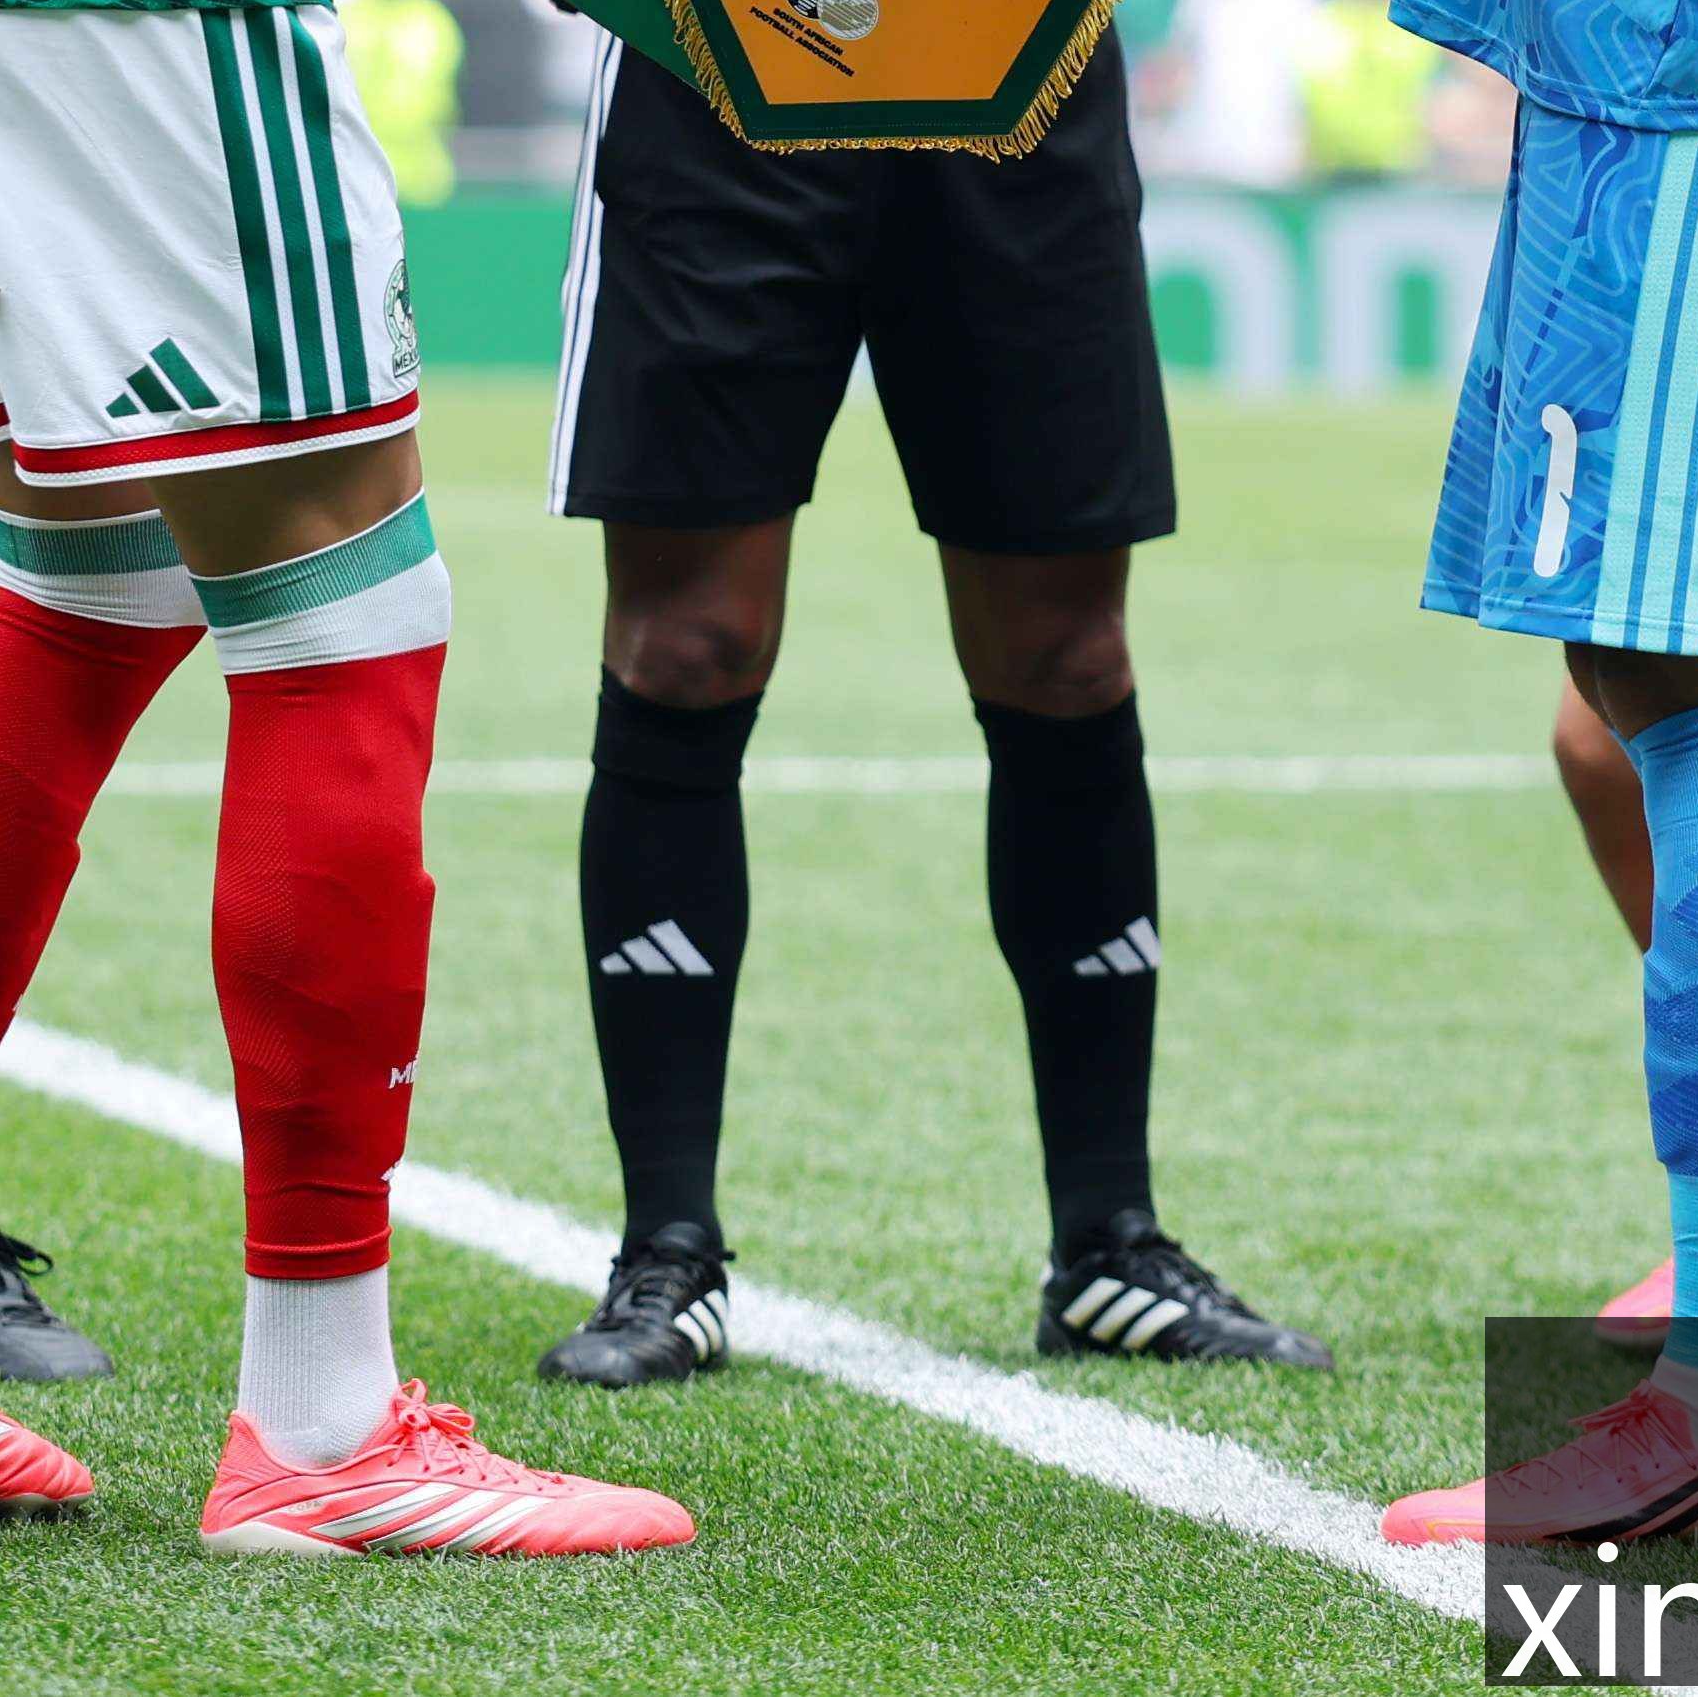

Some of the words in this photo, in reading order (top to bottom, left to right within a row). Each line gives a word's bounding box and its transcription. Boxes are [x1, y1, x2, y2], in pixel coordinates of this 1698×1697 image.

[749, 5, 796, 41] FOOTBALL
[795, 36, 855, 78] ASSOCIATION
[772, 7, 805, 32] SOUTH
[803, 27, 844, 57] AFRICAN
[1534, 404, 1578, 578] 1
